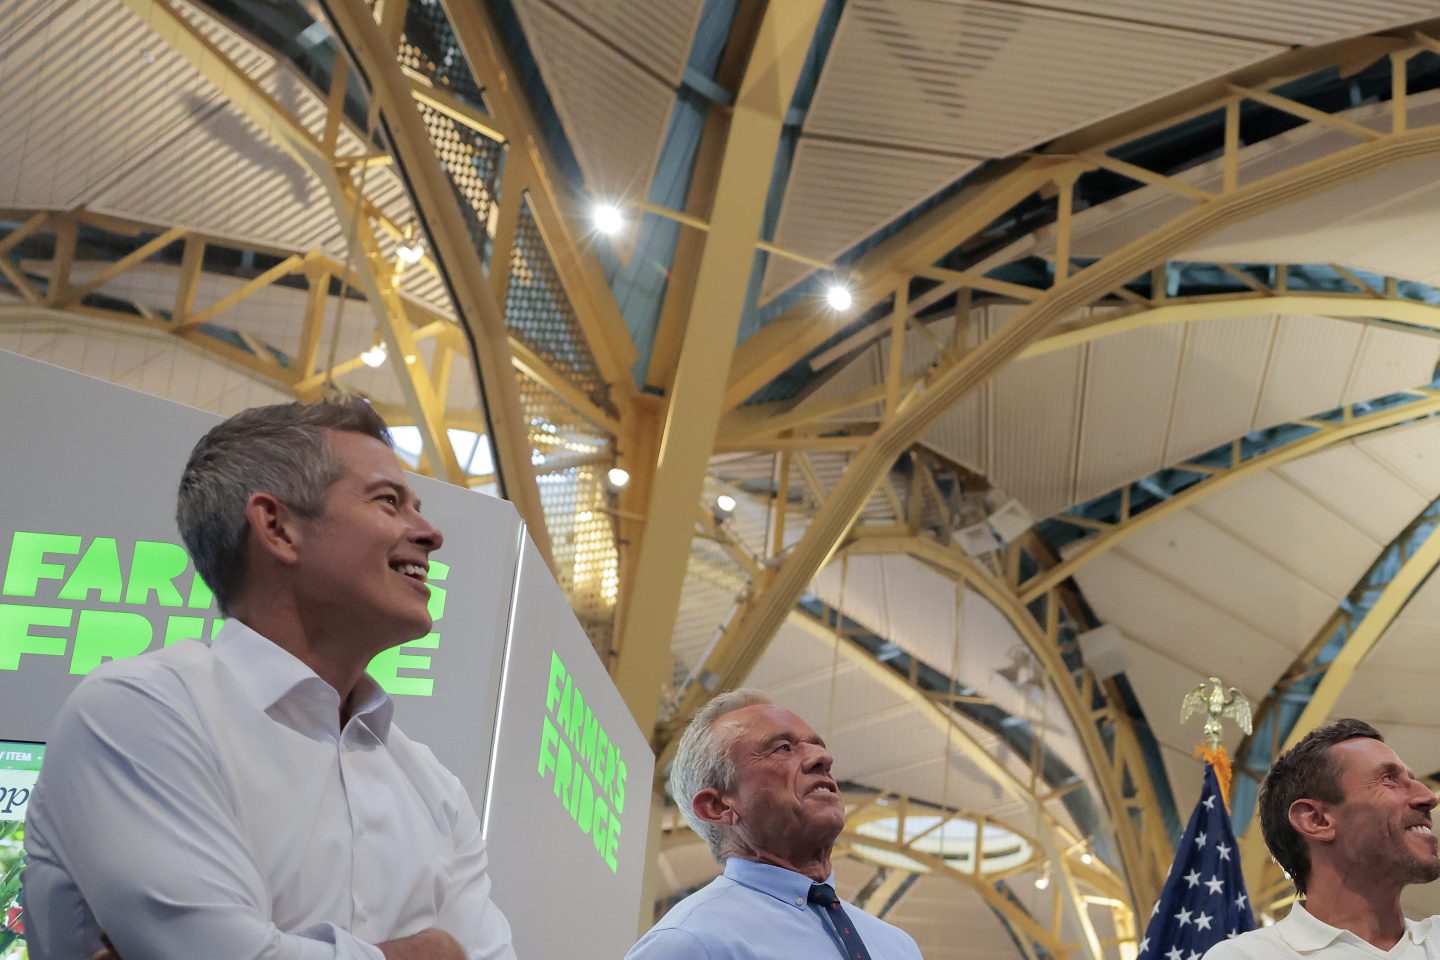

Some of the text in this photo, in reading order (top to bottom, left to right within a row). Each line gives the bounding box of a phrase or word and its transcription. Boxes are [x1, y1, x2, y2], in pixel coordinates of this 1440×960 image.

[6, 752, 32, 761] ITEM
[537, 714, 621, 875] FRIDGE
[546, 649, 628, 815] FARMER'S
